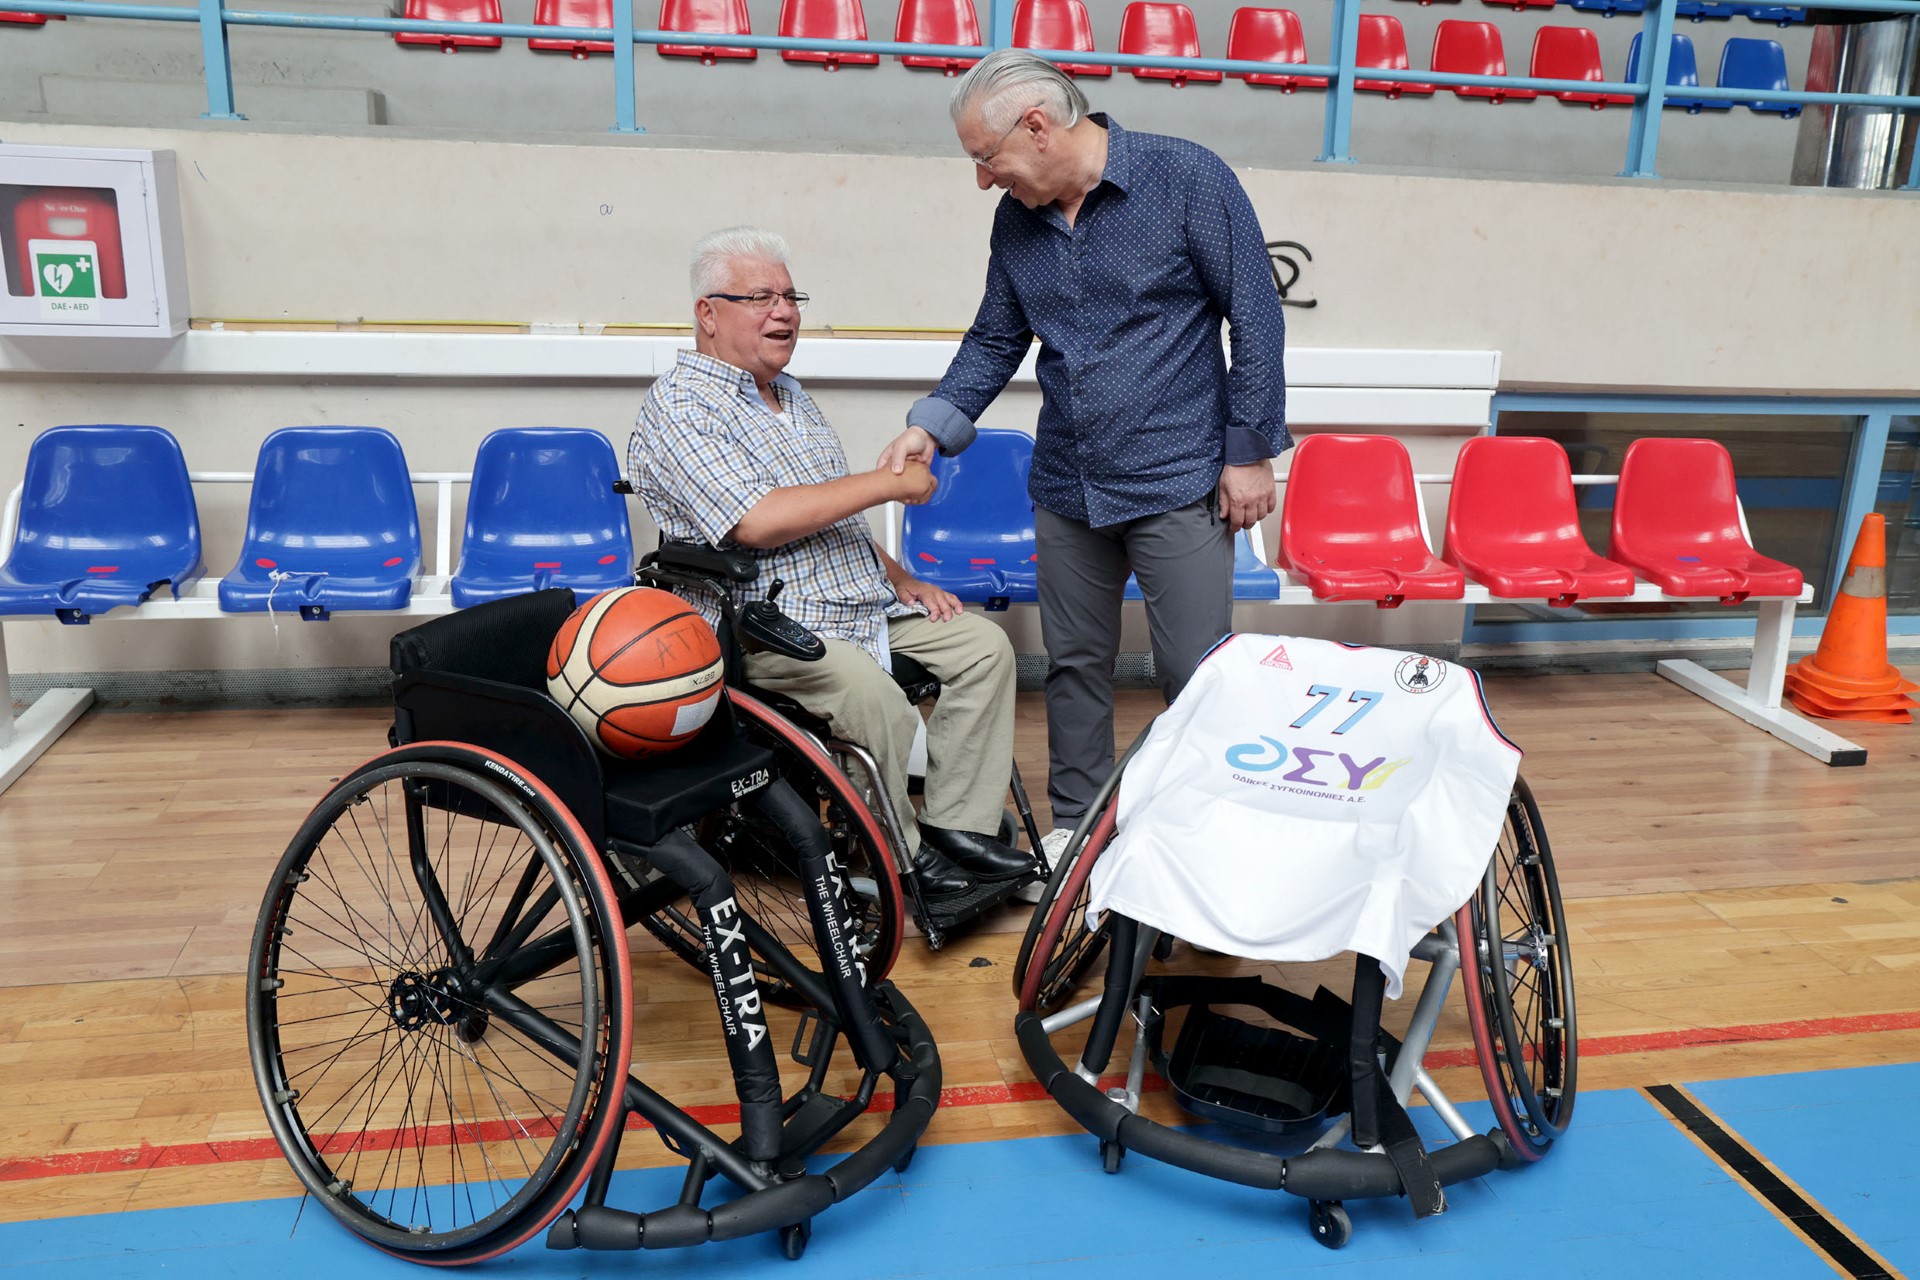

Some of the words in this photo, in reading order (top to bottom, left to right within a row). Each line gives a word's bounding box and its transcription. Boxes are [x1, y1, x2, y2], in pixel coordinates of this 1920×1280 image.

[51, 302, 67, 310] DAE
[73, 303, 90, 311] AED
[1288, 684, 1384, 735] 77
[731, 768, 769, 793] EX-TRA
[815, 875, 830, 900] THE
[702, 924, 715, 950] THE
[822, 901, 852, 979] WHEELCHAIR
[710, 896, 767, 1052] EX-TRA
[708, 952, 738, 1037] WHEELCHAIR
